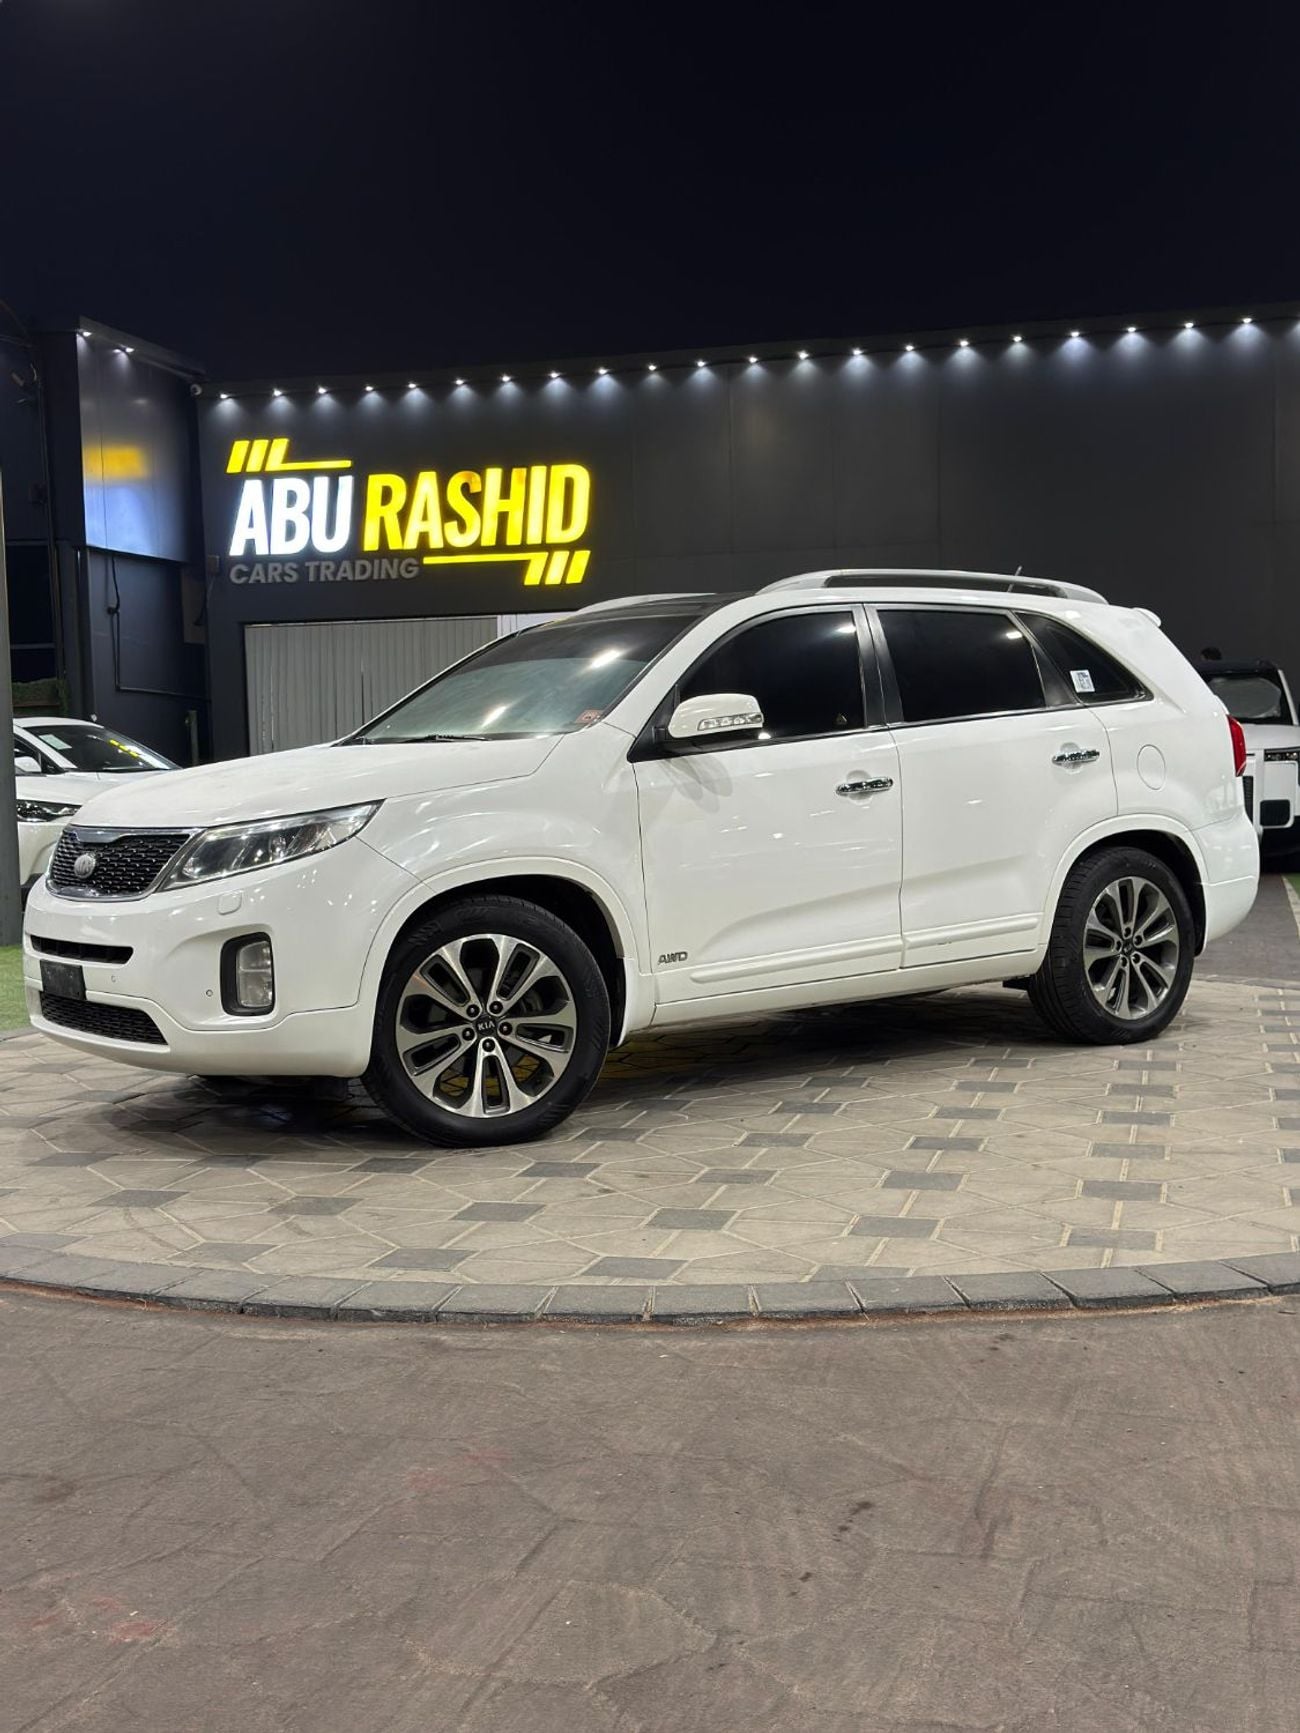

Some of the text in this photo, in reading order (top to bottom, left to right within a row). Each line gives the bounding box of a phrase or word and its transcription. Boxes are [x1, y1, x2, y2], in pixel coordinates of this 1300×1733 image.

[229, 464, 591, 556] ABU RASHID
[229, 557, 419, 584] CARS TRADING
[657, 951, 688, 965] AWD
[477, 1020, 496, 1031] KIA
